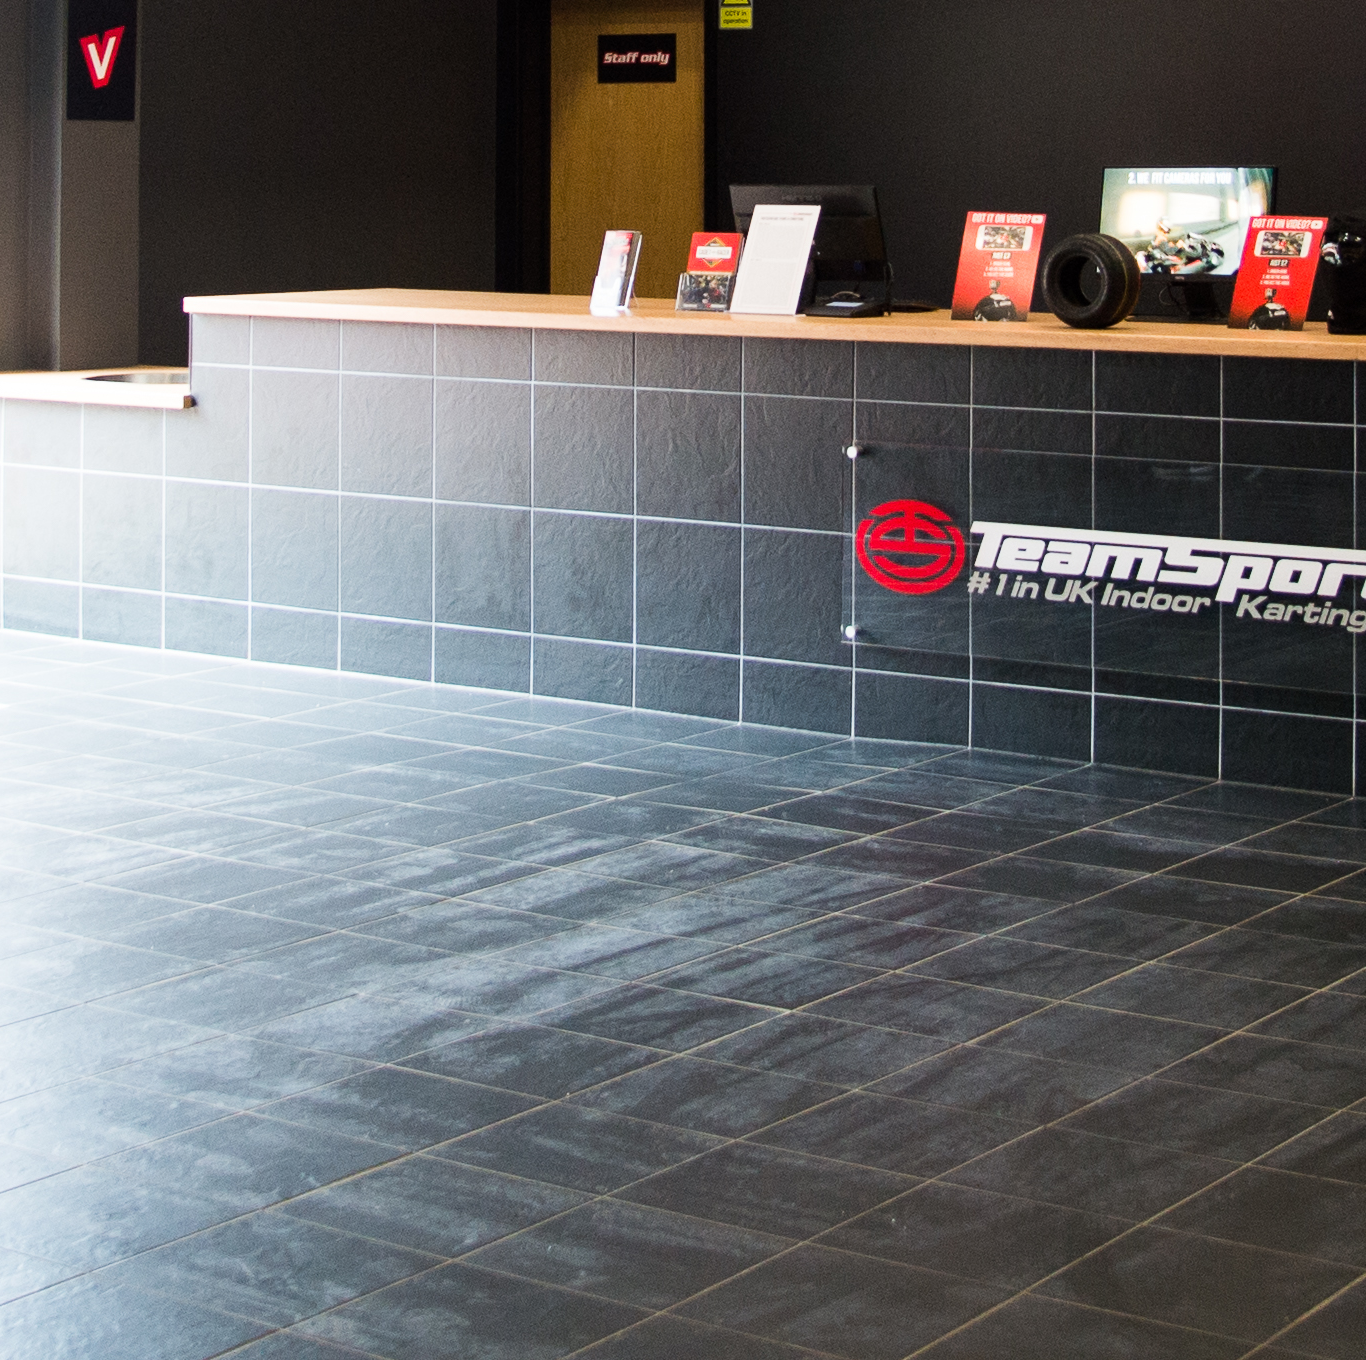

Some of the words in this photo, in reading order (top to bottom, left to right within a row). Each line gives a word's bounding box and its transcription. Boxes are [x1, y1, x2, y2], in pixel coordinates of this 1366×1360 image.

[603, 51, 640, 64] Staff
[640, 51, 671, 66] only
[1137, 172, 1150, 184] WE
[1151, 172, 1164, 184] FIT
[1164, 172, 1200, 184] CAMERAS
[1200, 172, 1215, 184] FOR
[1216, 172, 1232, 184] YOU
[972, 213, 986, 223] GOT
[987, 214, 994, 223] IT
[1006, 214, 1031, 224] VIDEO?
[1251, 218, 1266, 228] GOT
[1266, 218, 1274, 228] IT
[1274, 219, 1285, 228] ON
[1286, 219, 1311, 229] VIDEO?
[1012, 574, 1040, 599] in
[1044, 578, 1095, 604] UK
[1100, 582, 1212, 614] Indoor
